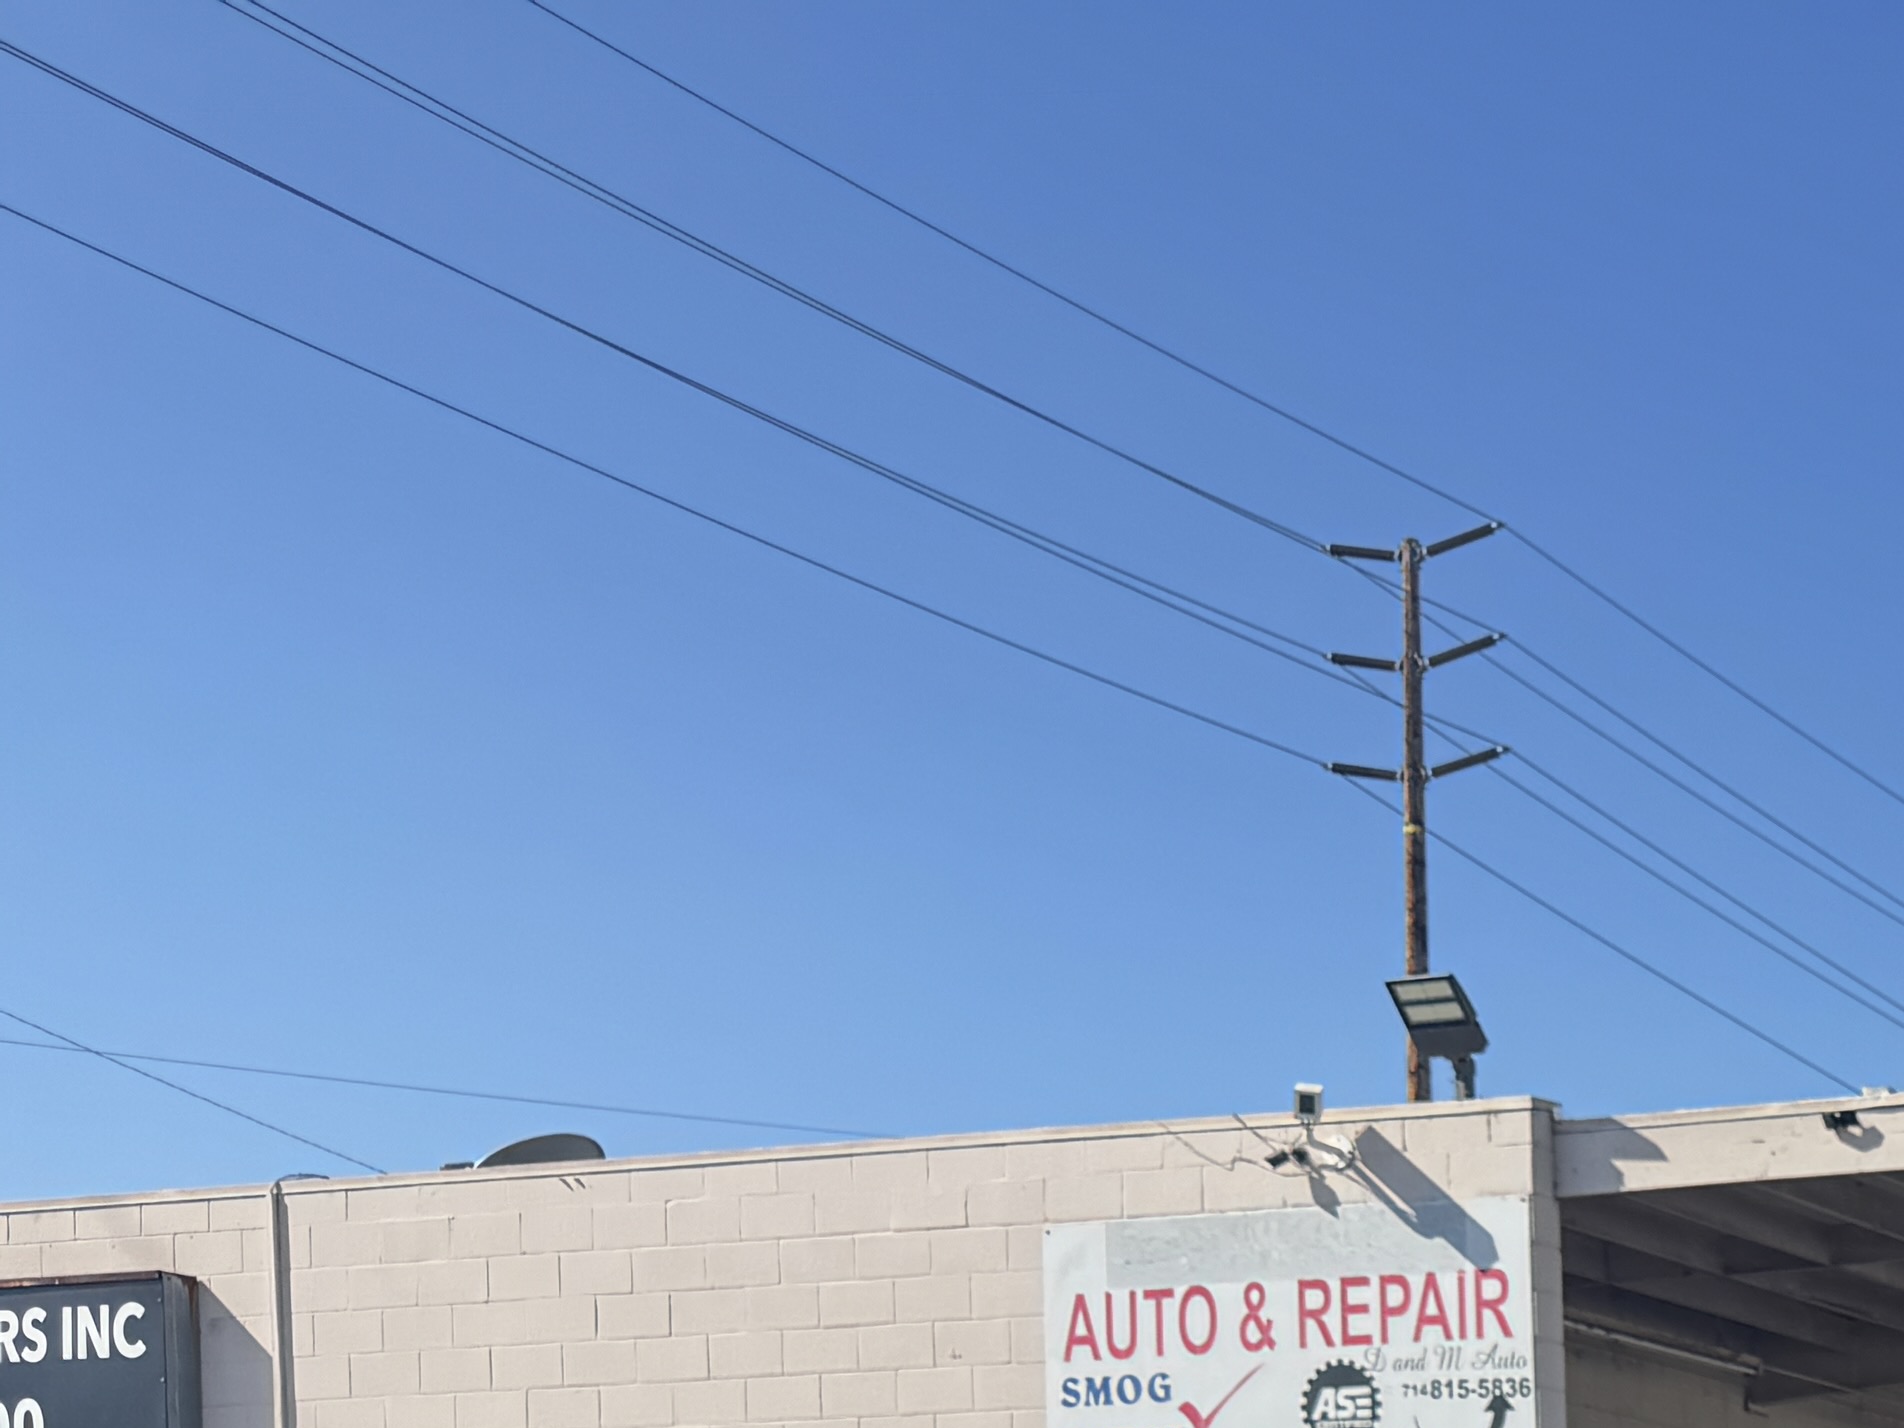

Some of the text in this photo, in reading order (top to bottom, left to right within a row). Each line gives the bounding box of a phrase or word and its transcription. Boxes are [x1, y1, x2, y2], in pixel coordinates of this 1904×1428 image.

[62, 1301, 147, 1360] INC
[1063, 1267, 1514, 1363] AUTO & REPAIR
[1363, 1346, 1387, 1373] D
[1393, 1347, 1427, 1372] and
[1471, 1344, 1528, 1371] Auto
[1062, 1373, 1172, 1407] SMOG
[1311, 1385, 1373, 1420] ASE
